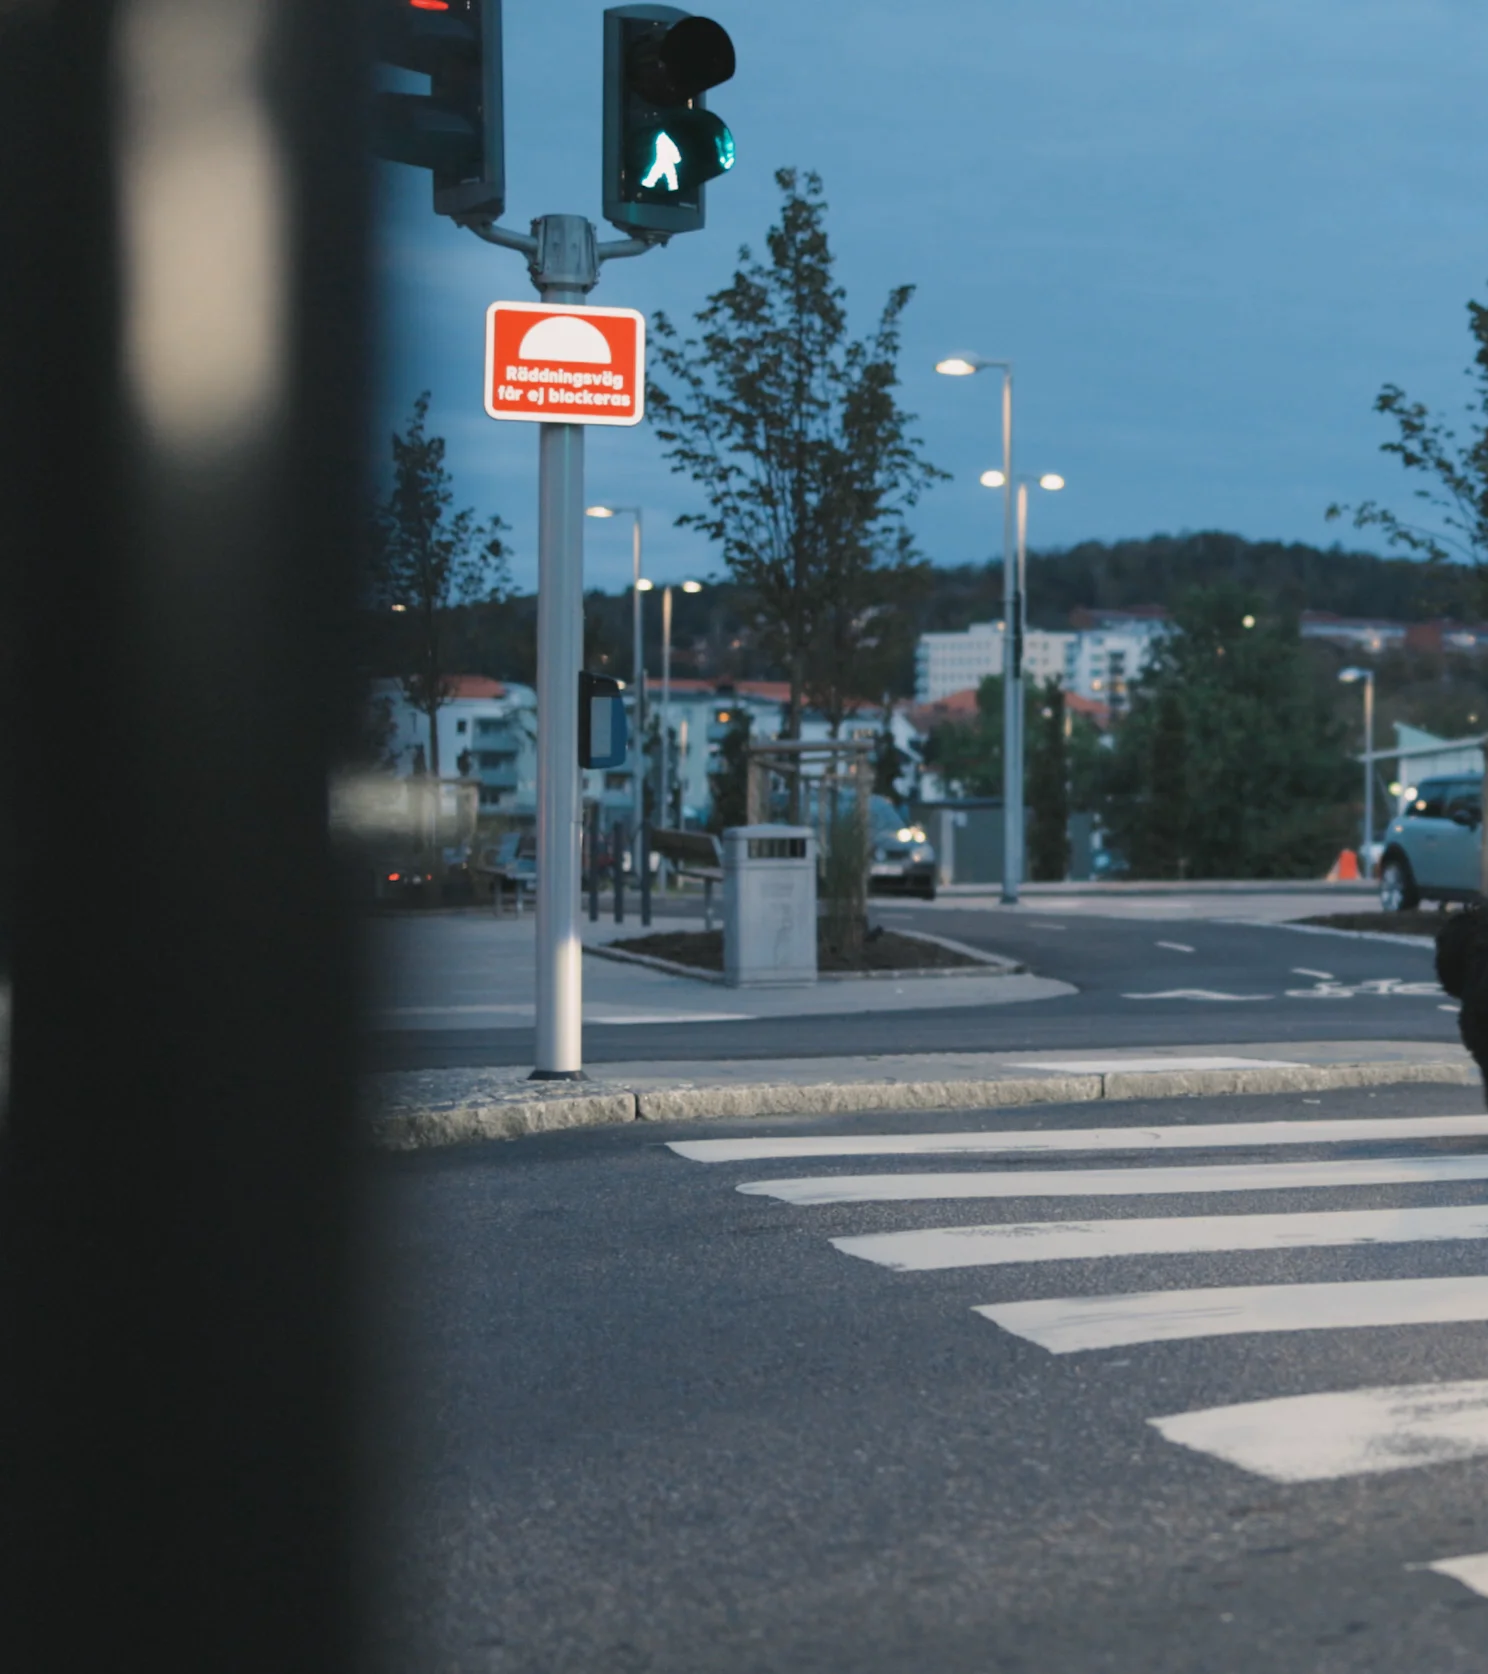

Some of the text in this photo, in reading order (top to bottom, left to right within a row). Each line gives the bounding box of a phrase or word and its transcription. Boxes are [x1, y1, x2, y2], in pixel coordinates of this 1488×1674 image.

[506, 365, 624, 390] Räddningsväg
[498, 385, 631, 407] får ej blockeras
